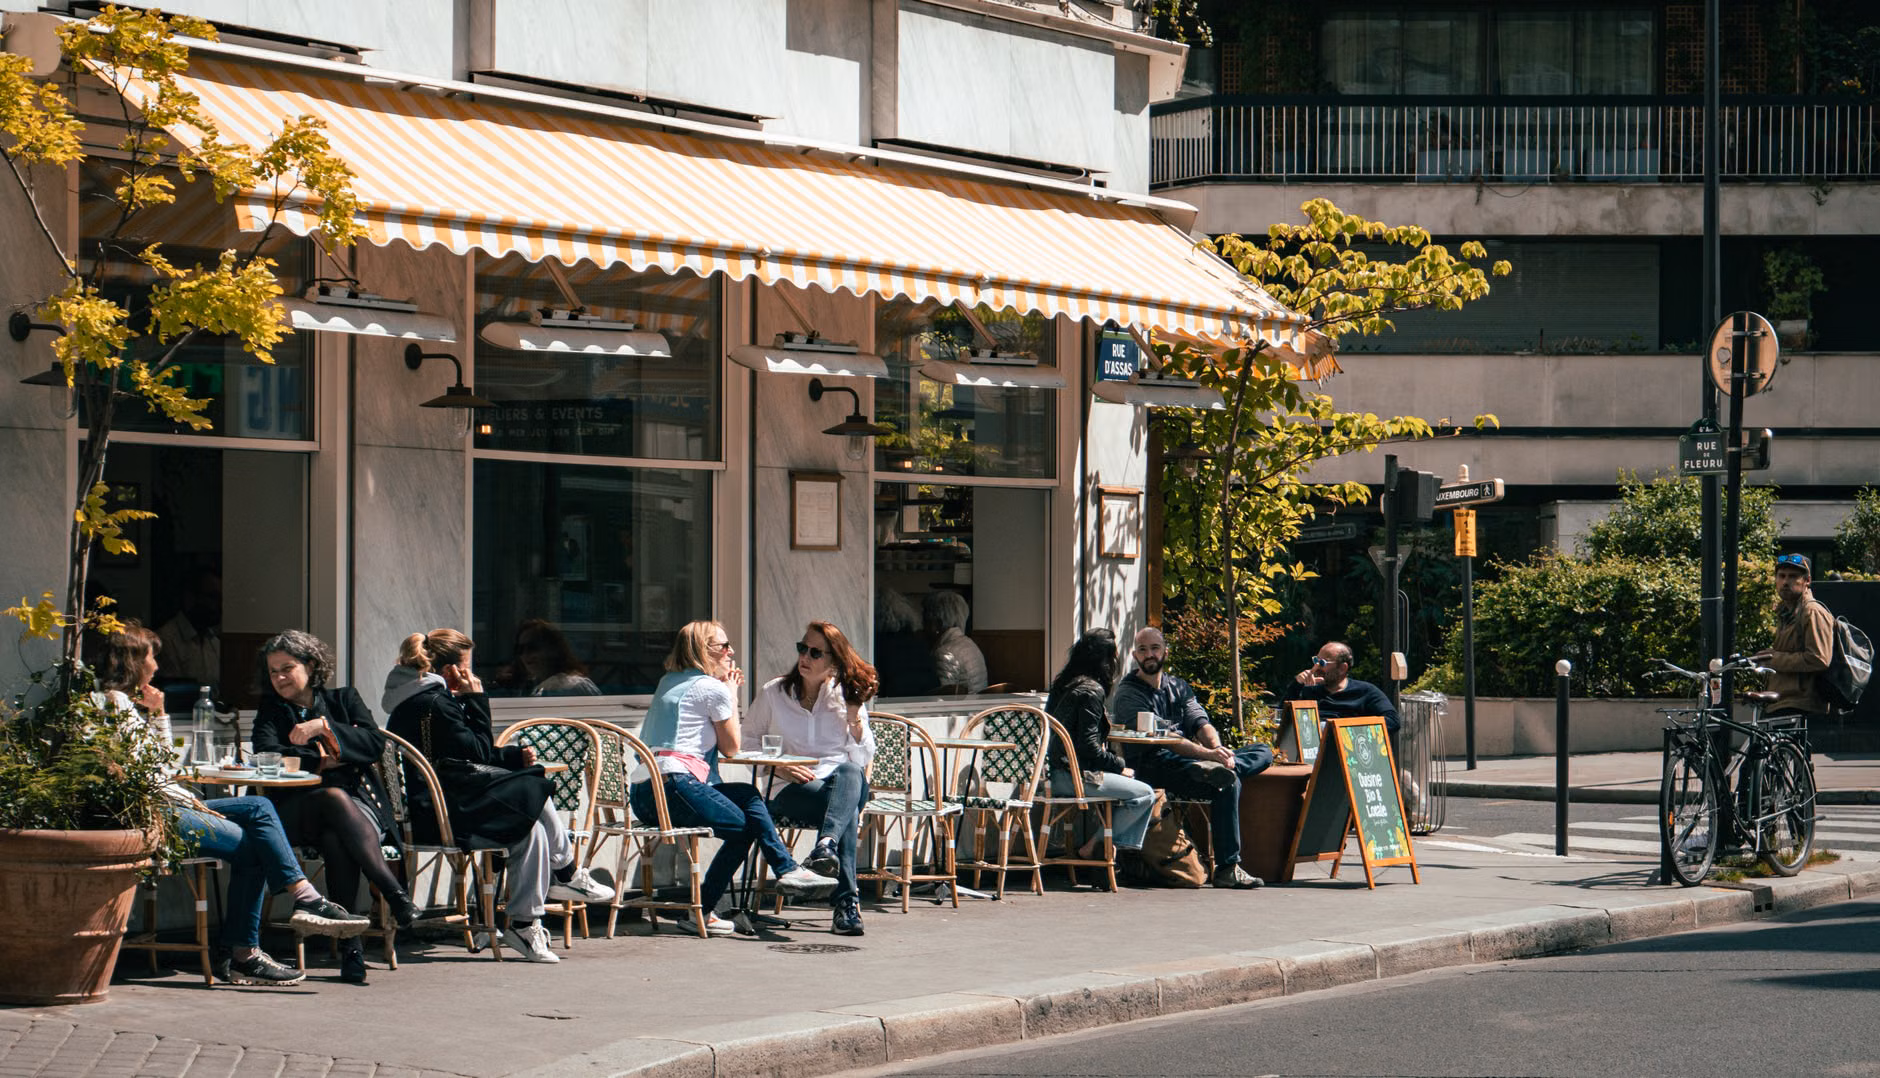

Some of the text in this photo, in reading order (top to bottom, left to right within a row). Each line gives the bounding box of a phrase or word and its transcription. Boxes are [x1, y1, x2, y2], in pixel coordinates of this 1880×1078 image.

[1112, 344, 1126, 358] RUE
[1104, 360, 1133, 376] D'ASSAS
[552, 406, 604, 420] EVENTS
[1696, 441, 1717, 451] RUE
[1684, 459, 1723, 469] FLEURU
[1436, 488, 1479, 501] UXEMBOURG
[1358, 772, 1383, 788] Cuisine
[1364, 789, 1376, 803] Bio
[1366, 802, 1388, 818] Locale
